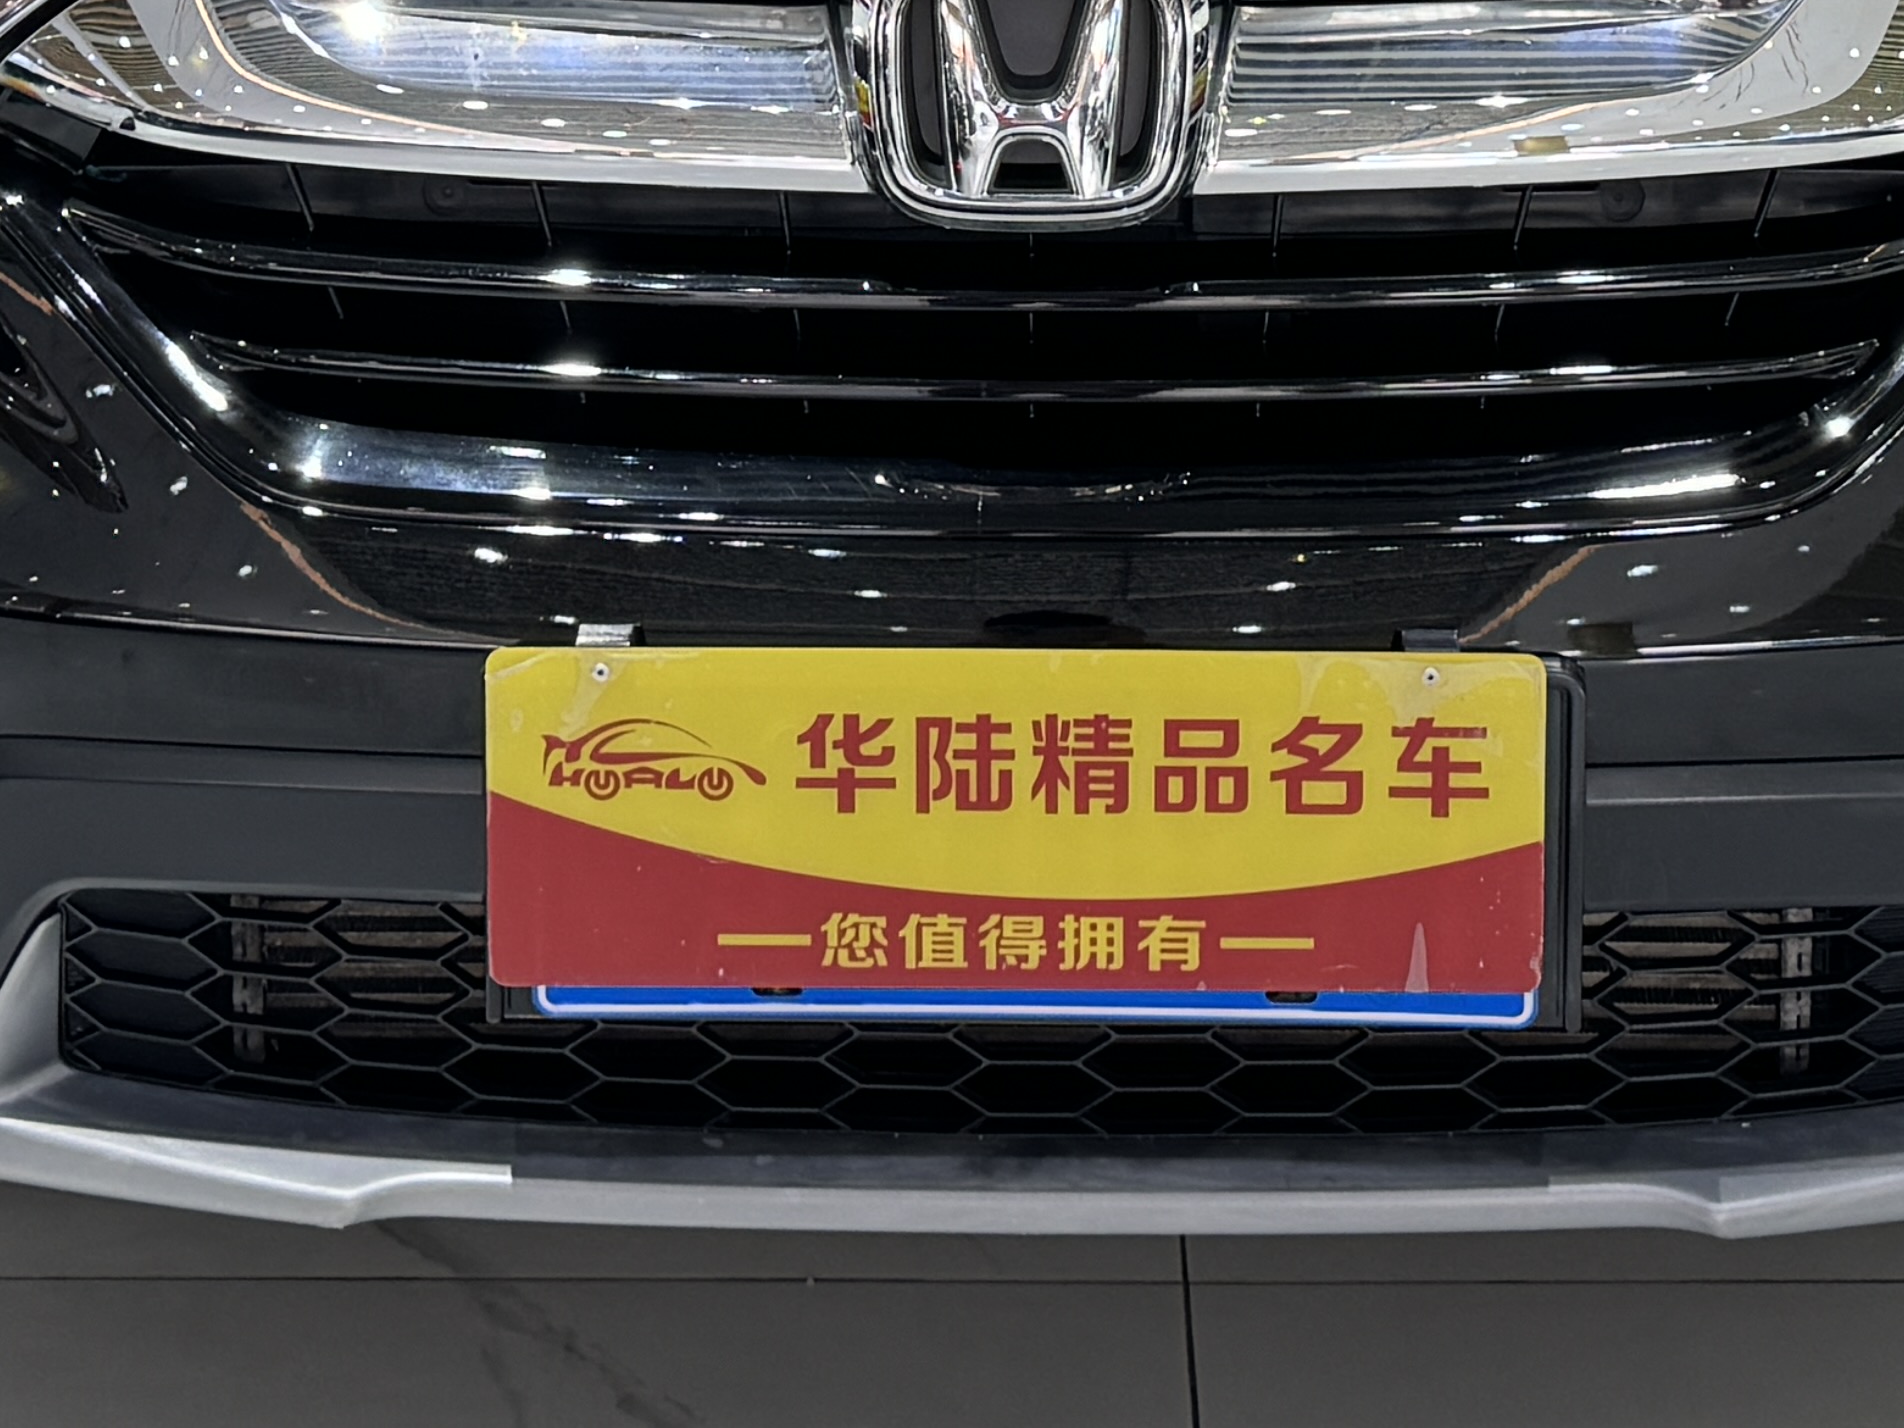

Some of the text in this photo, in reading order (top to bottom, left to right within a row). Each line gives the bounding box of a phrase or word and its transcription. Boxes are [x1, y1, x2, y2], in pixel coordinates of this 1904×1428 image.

[795, 711, 1493, 819] 华陆精品名车
[820, 910, 1208, 972] 您值得拥有
